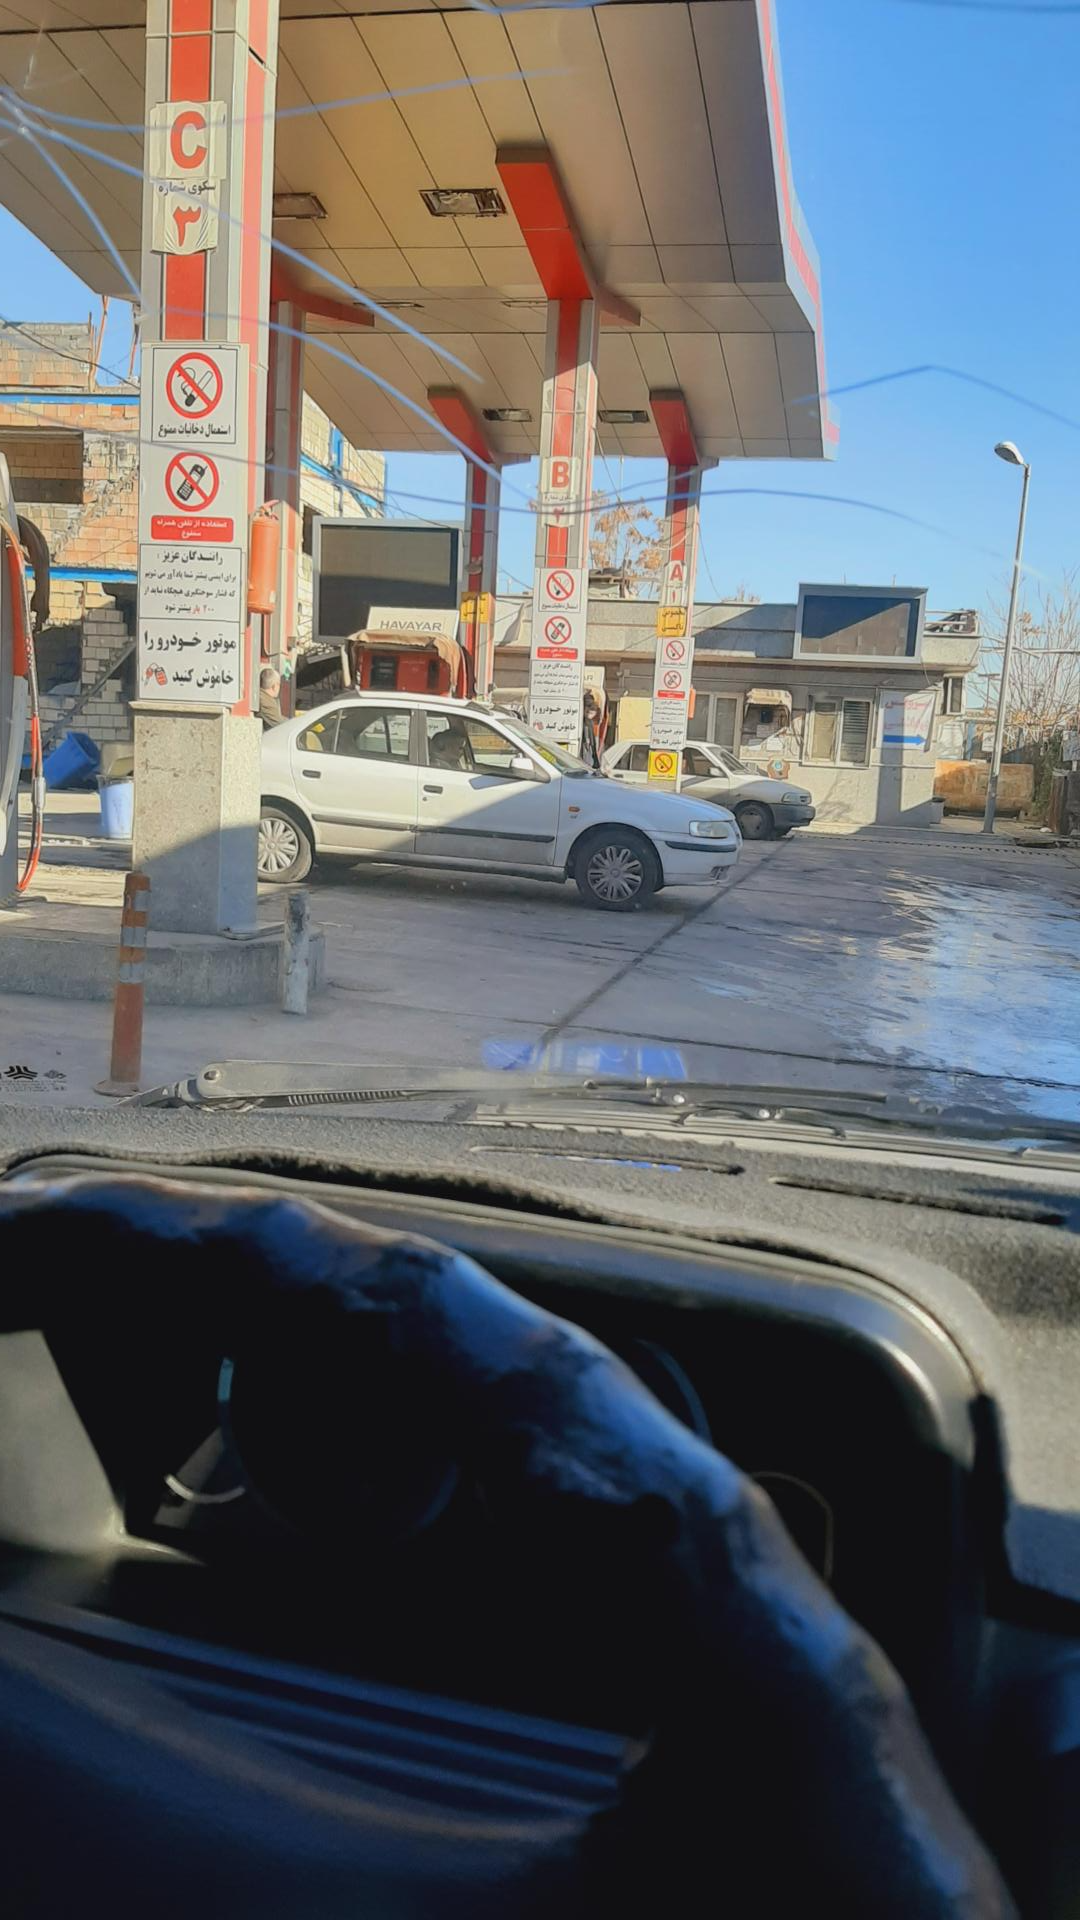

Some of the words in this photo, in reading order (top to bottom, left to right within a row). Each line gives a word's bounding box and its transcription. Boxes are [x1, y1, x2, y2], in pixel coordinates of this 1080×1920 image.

[170, 110, 208, 169] C
[158, 181, 185, 196] شماره
[188, 180, 216, 195] سکوی
[172, 205, 202, 247] ۳
[158, 423, 176, 438] ممنوع
[178, 422, 203, 438] دخانیات
[205, 423, 231, 437] استعمال
[551, 461, 570, 488] B
[161, 550, 180, 563] عزیز
[181, 549, 223, 566] رانندگان
[670, 564, 683, 581] A
[380, 620, 442, 631] HAVAYAR
[144, 630, 154, 651] را
[156, 631, 202, 652] خودرو
[205, 632, 237, 654] موتور
[172, 668, 194, 687] کنید
[196, 668, 234, 689] خاموش
